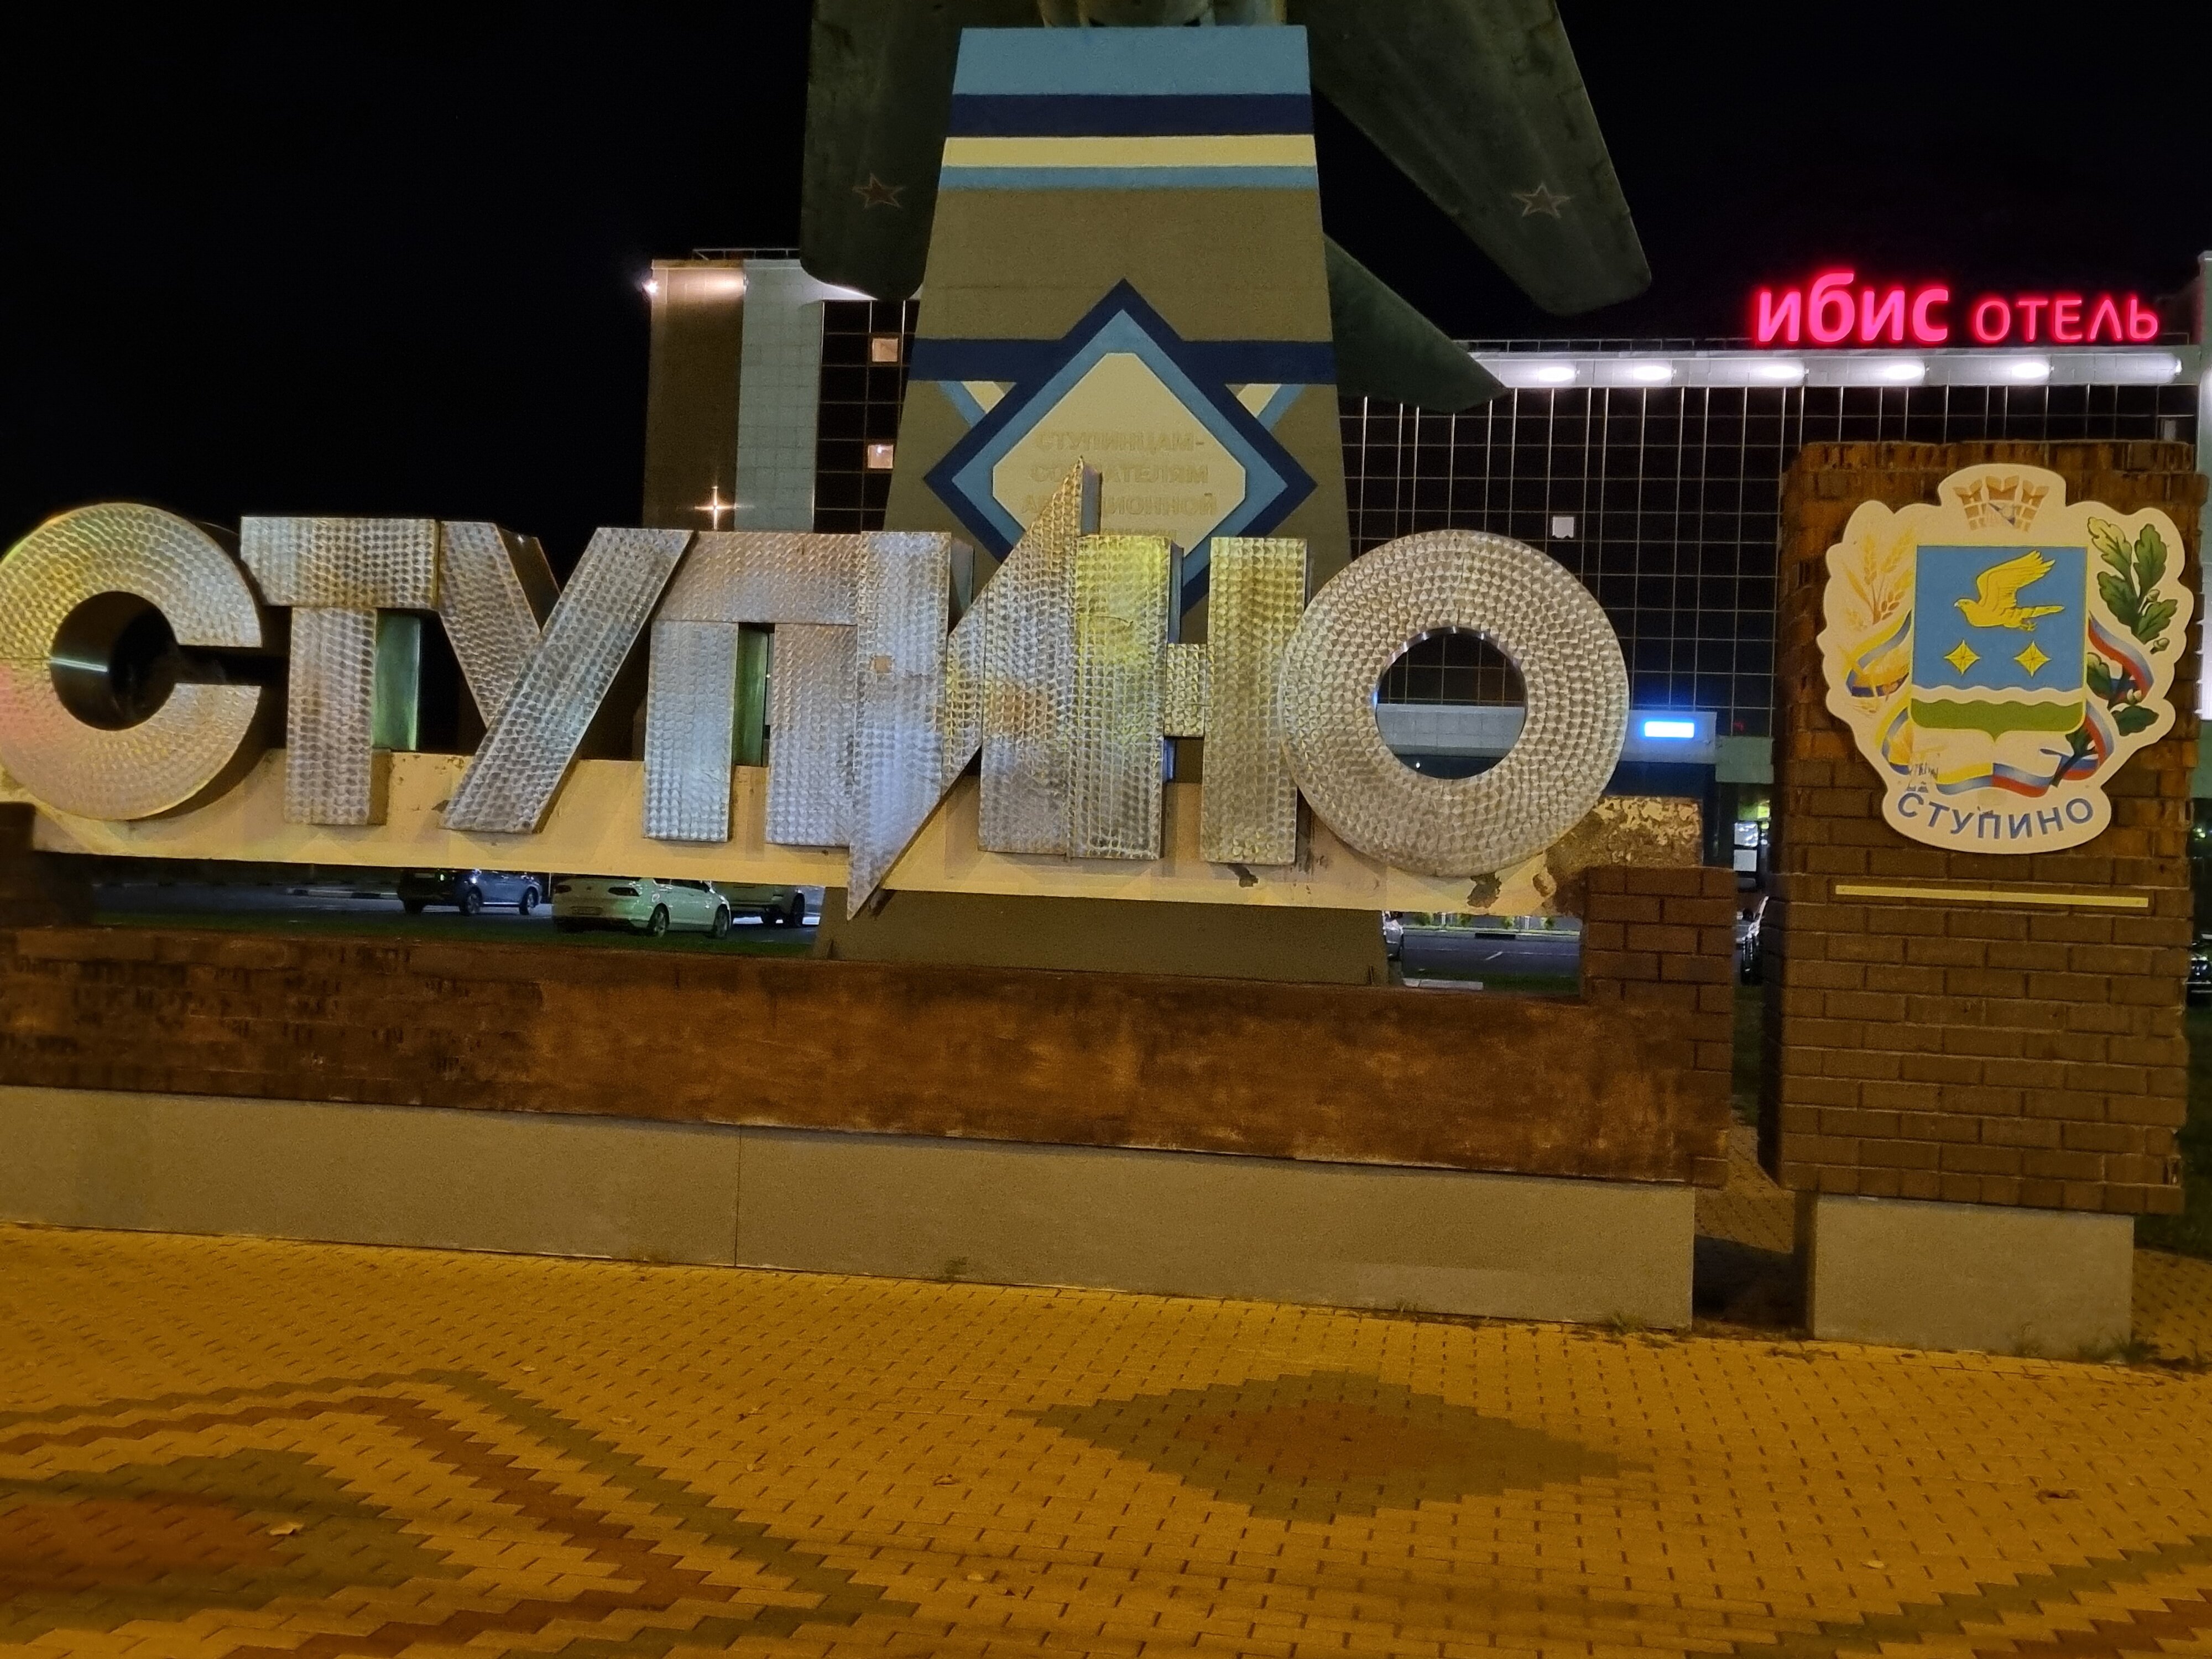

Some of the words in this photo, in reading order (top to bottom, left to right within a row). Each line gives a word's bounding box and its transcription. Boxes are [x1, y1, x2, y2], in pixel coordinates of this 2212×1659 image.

[1756, 272, 1949, 342] ибис
[1975, 295, 2159, 342] ОТЕЛЬ
[1030, 463, 1209, 484] СОАТЕЛЯМ
[0, 455, 1630, 919] СТУПИНО
[1897, 792, 2094, 839] СТУПИНО
